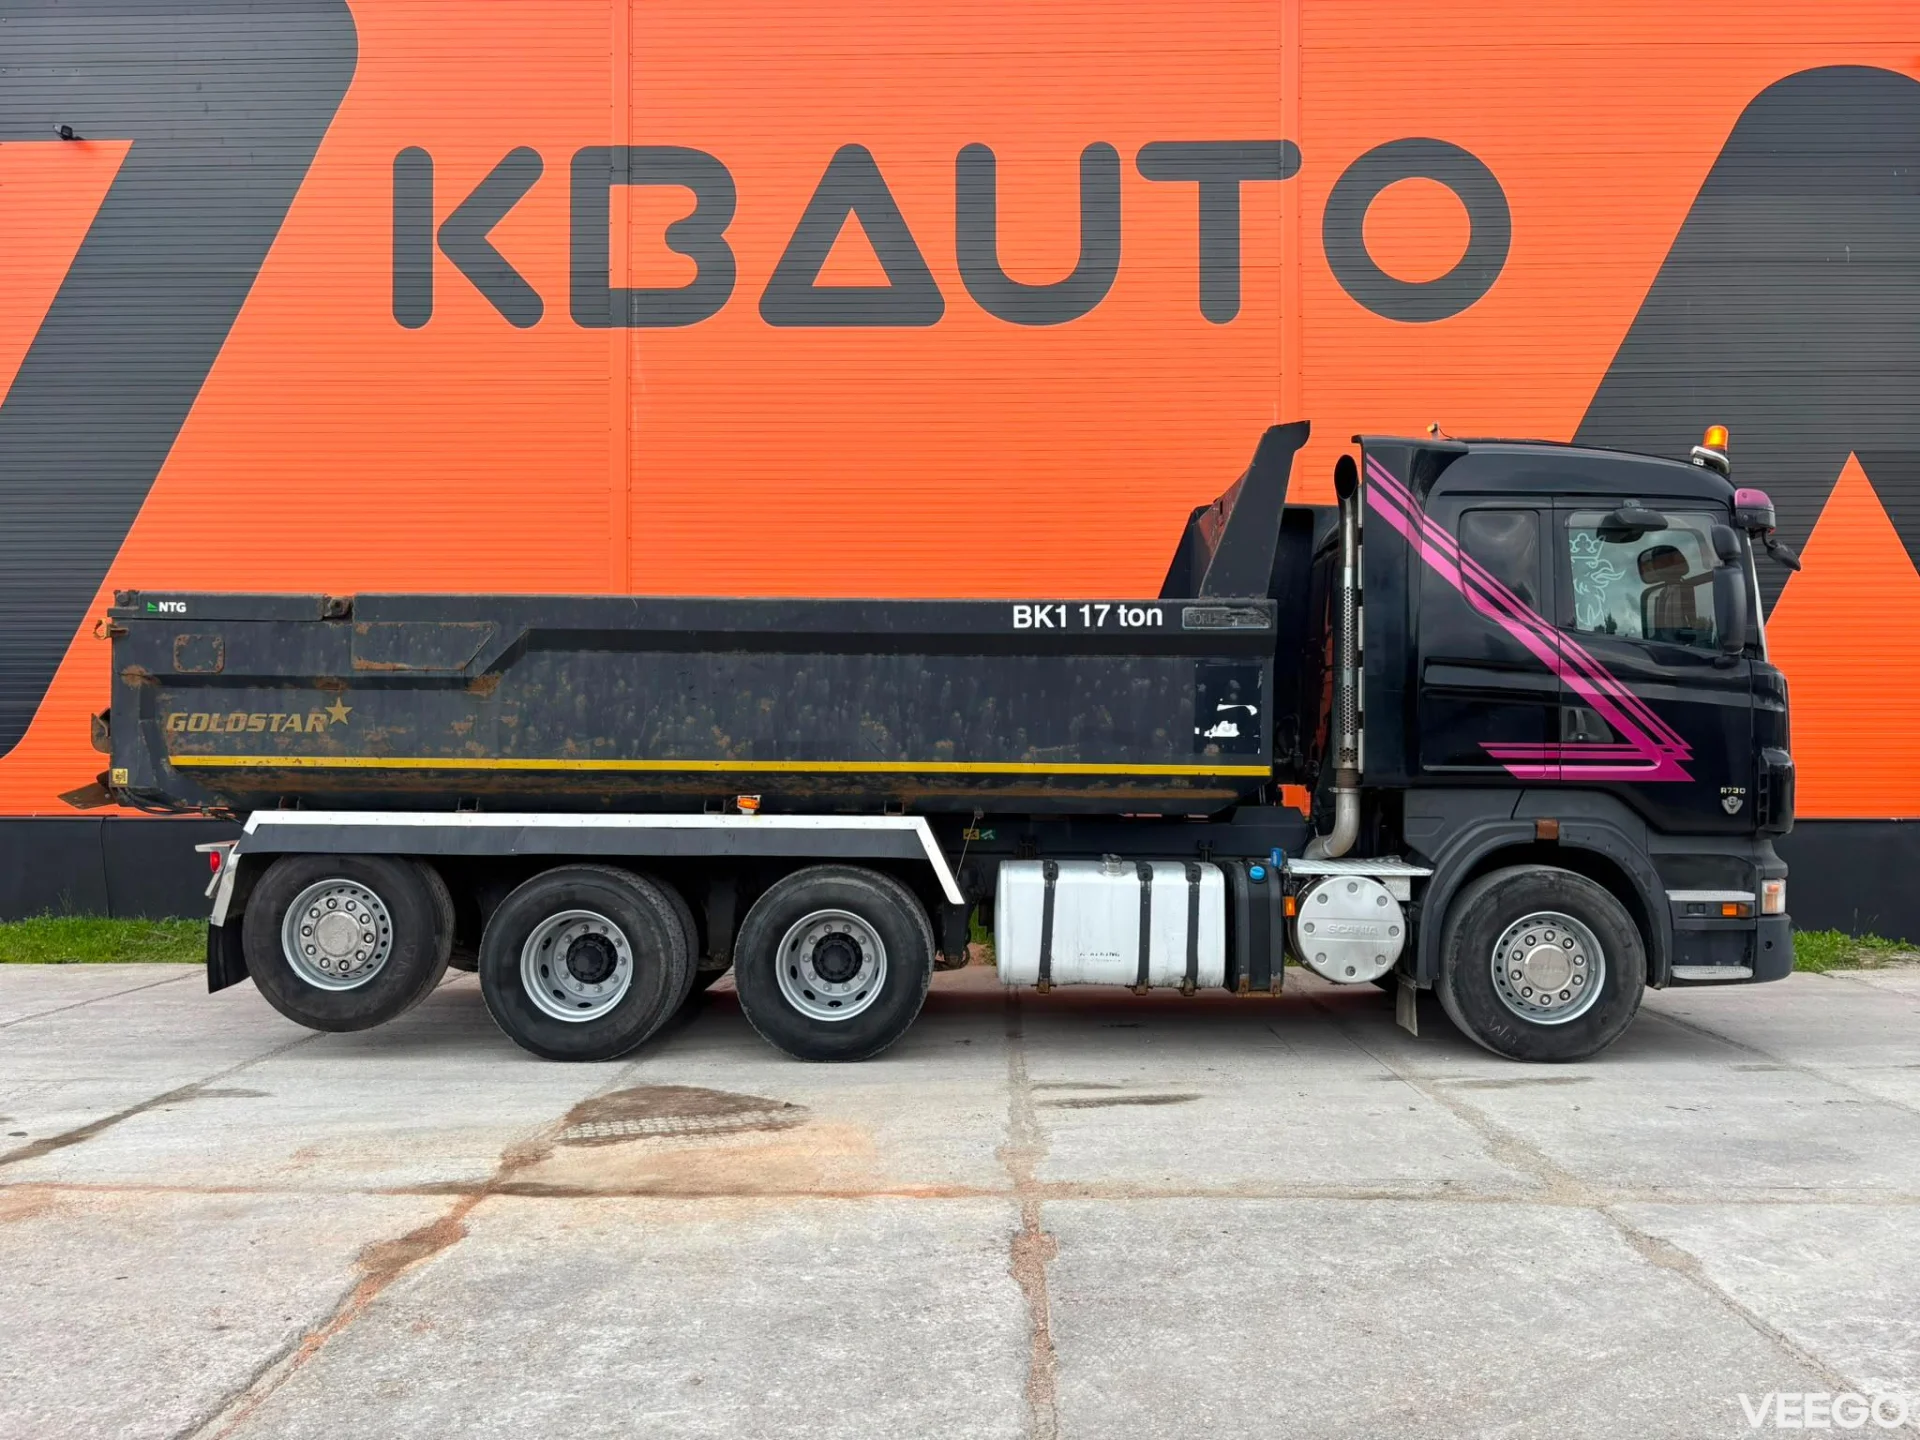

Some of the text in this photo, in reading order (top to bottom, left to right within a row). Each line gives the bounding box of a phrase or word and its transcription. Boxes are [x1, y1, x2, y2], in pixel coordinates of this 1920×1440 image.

[393, 137, 1512, 329] KBAUTO
[158, 601, 187, 613] NTG
[1012, 604, 1067, 629] BK1
[1079, 603, 1111, 627] 17
[1117, 604, 1163, 627] ton
[166, 712, 329, 732] GOLDSTAR
